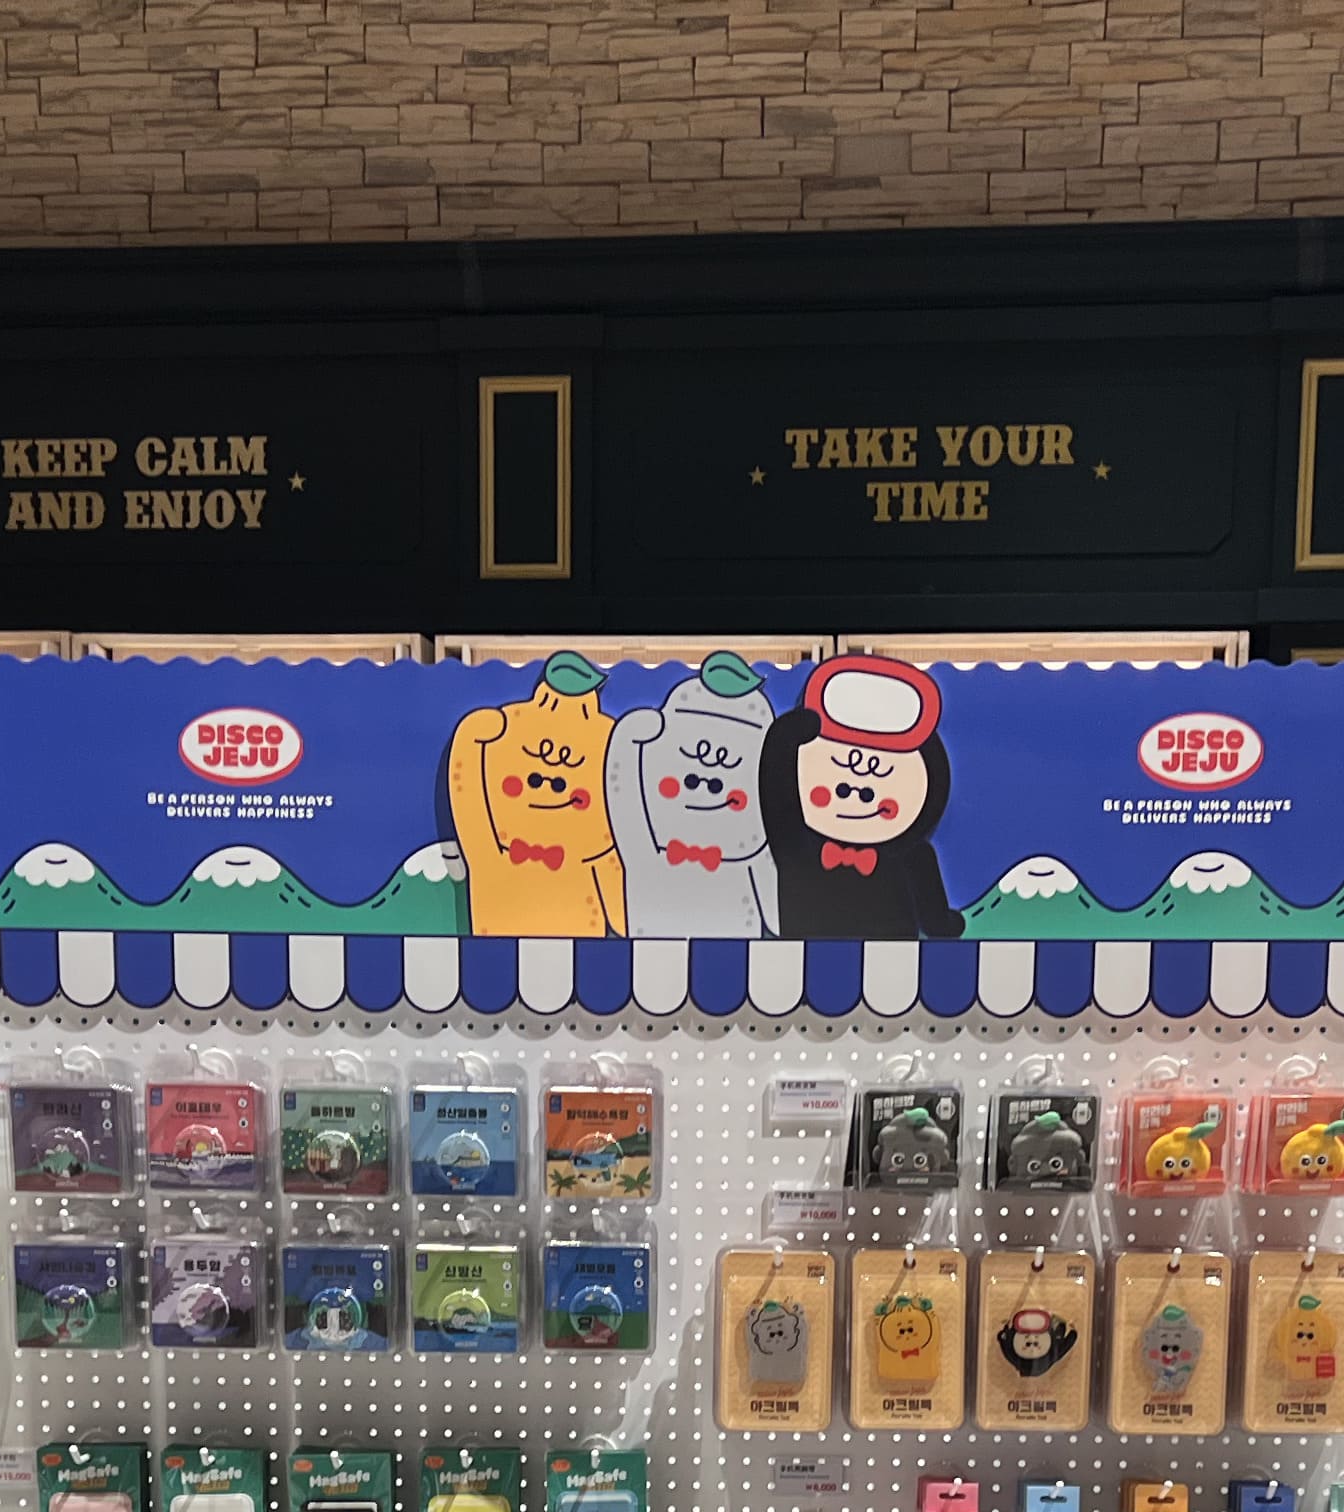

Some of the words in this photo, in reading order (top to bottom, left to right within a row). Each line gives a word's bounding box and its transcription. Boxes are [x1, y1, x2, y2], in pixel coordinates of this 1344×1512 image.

[1, 438, 118, 478] KEEP
[134, 435, 268, 477] CALM
[785, 426, 917, 469] TAKE
[936, 424, 1074, 468] YOUR
[5, 491, 105, 531] AND
[123, 489, 267, 530] ENJOY
[866, 480, 989, 522] TIME
[197, 724, 284, 746] DISCO
[1158, 729, 1244, 751] DISCO
[203, 746, 280, 768] JEJU
[1161, 751, 1240, 773] JEJU
[147, 792, 164, 805] BE
[167, 794, 178, 805] A
[181, 794, 236, 806] PERSON
[241, 795, 273, 806] WHO
[279, 794, 334, 807] ALWAYS
[1103, 799, 1121, 812] BE
[1124, 800, 1134, 811] A
[1137, 800, 1193, 811] PERSON
[1198, 800, 1231, 811] WHO
[1237, 800, 1292, 811] ALWAYS
[166, 806, 231, 818] DELIVERS
[237, 807, 315, 819] HAPPINESS
[1122, 812, 1187, 824] DELIVERS
[1193, 812, 1272, 824] HAPPINESS
